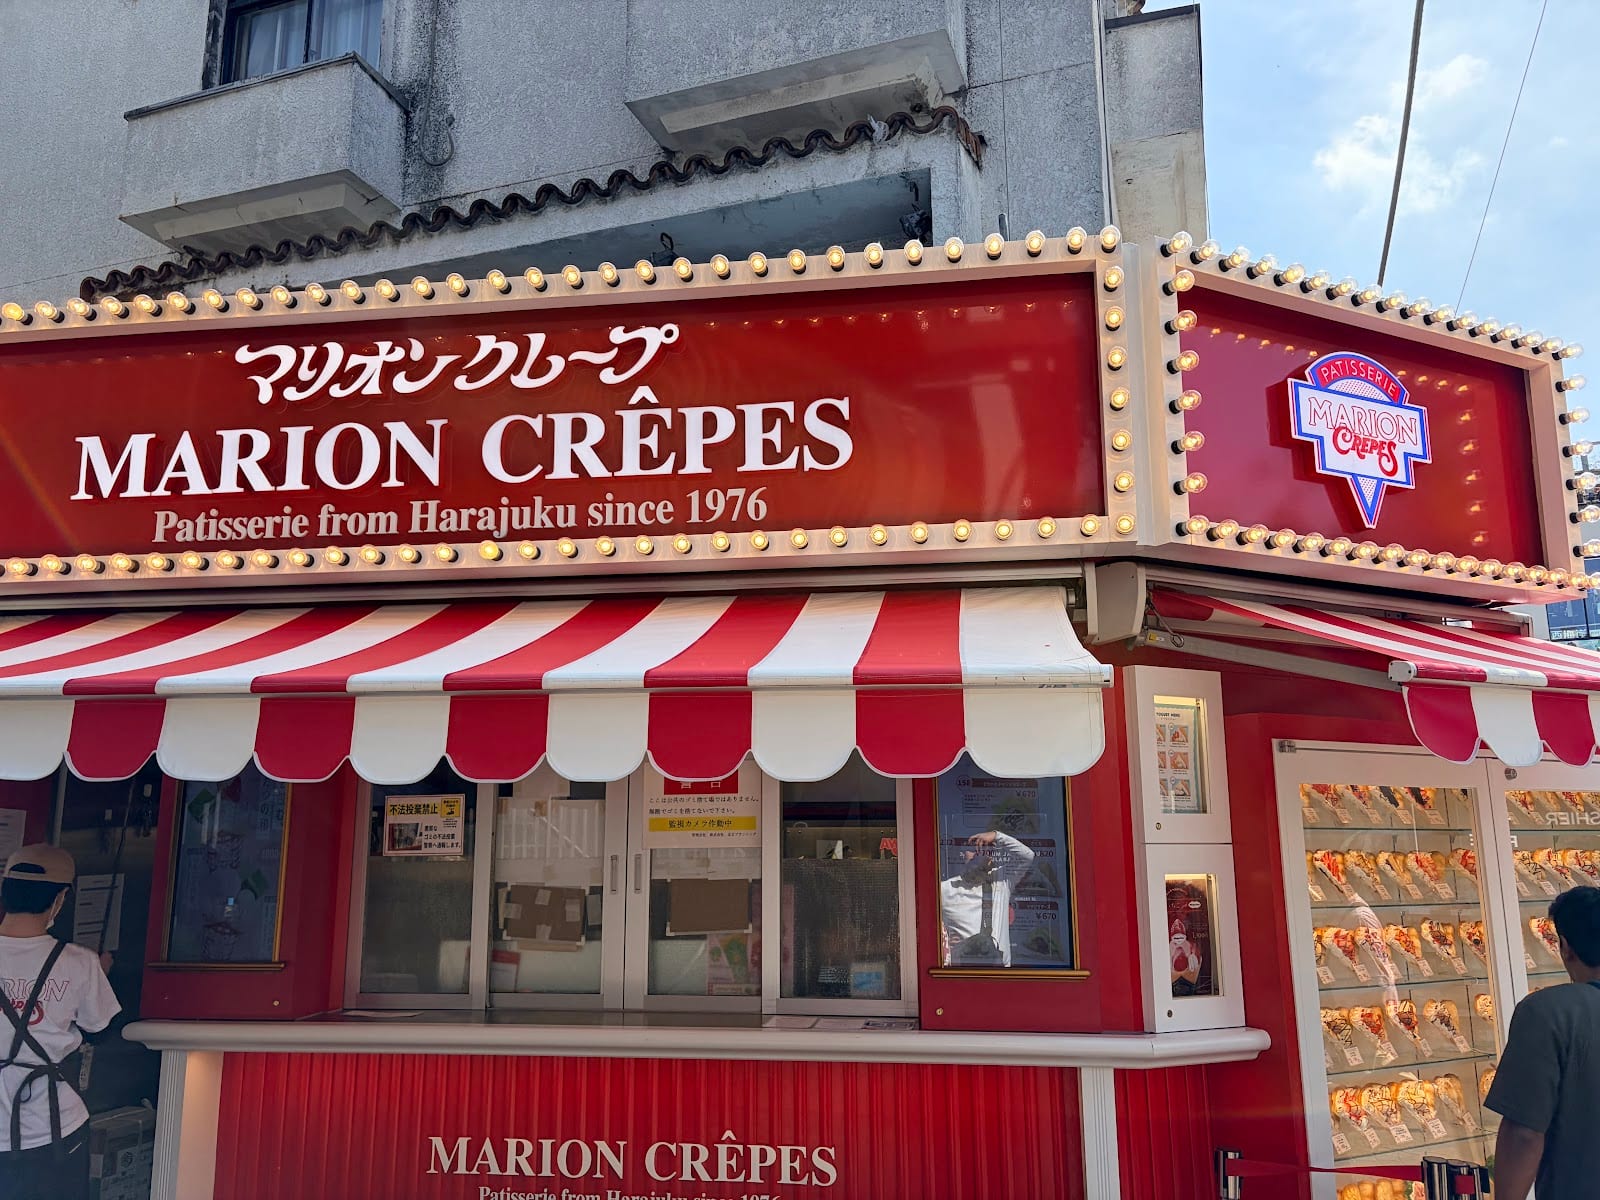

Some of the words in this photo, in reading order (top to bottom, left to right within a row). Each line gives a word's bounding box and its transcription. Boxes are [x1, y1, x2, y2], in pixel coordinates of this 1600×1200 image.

[234, 324, 679, 404] マリオンクレープ
[1321, 359, 1398, 397] PATISSERIE
[71, 420, 447, 499] MARION
[482, 386, 852, 483] CRÊPES
[1308, 397, 1418, 446] MARION
[152, 505, 308, 543] Patisserie
[317, 503, 398, 537] from
[408, 495, 578, 539] Harajuku
[587, 492, 673, 527] since
[686, 487, 768, 523] 1976
[389, 803, 438, 816] 不法投棄禁止
[668, 819, 732, 829] 監視カメラ作動中
[427, 1137, 627, 1179] MARION
[645, 1131, 836, 1187] CRÊPES
